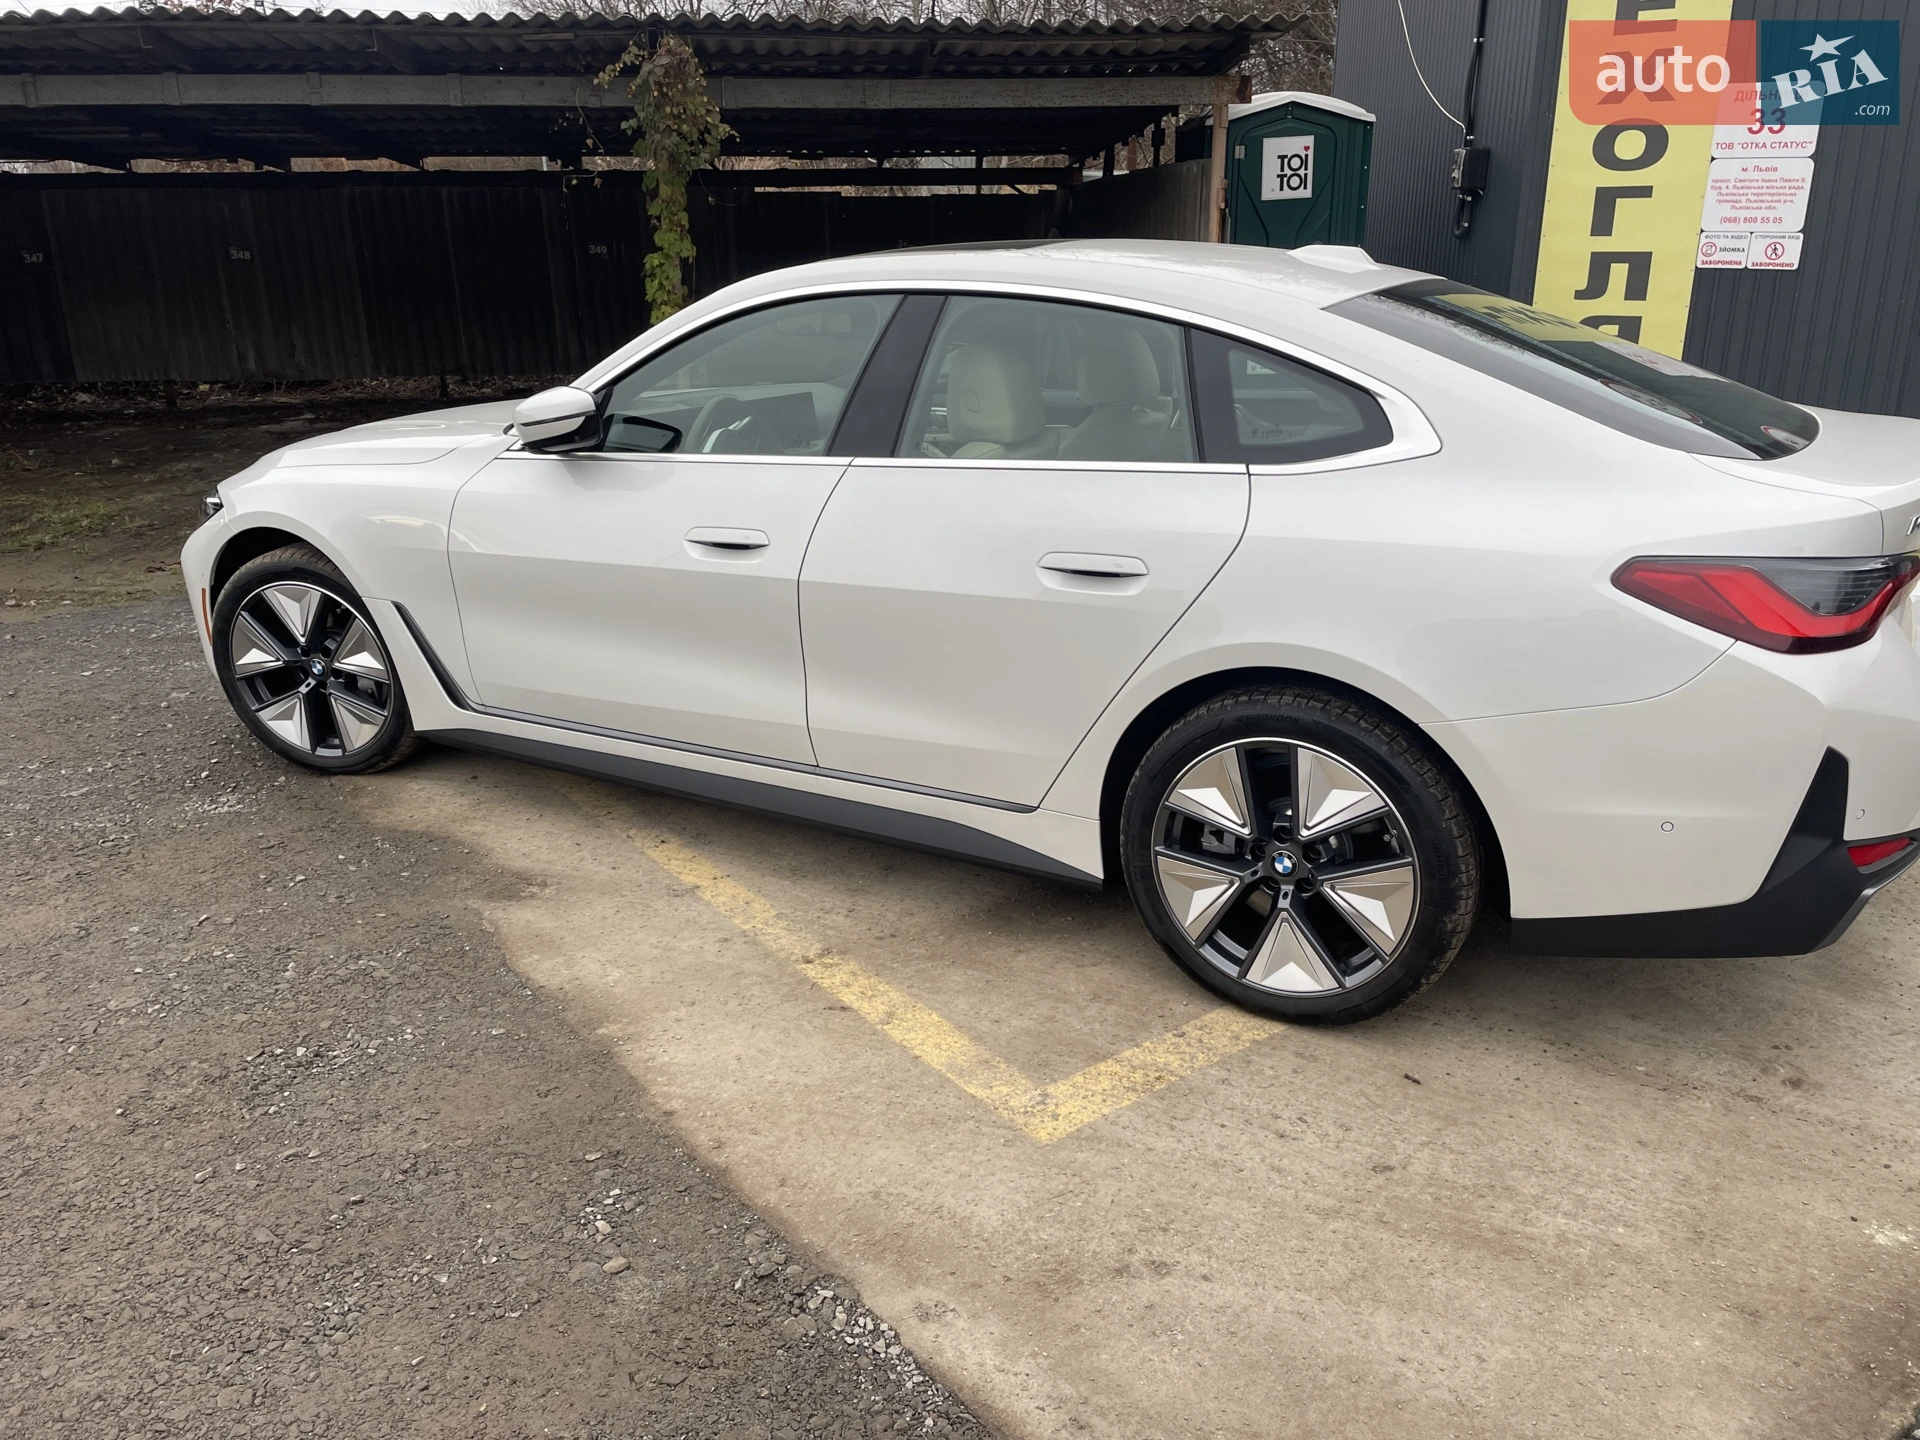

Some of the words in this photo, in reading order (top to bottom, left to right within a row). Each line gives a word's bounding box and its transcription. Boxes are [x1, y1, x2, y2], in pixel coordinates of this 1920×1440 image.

[1747, 108, 1787, 135] 33
[1715, 142, 1734, 150] ТОВ
[1737, 142, 1767, 150] "ОТКА
[1770, 141, 1813, 149] СТАТУС"
[1277, 153, 1309, 172] TOI
[1753, 165, 1779, 173] Львів
[1276, 172, 1308, 192] TOI
[1719, 217, 1741, 225] (068)
[588, 244, 607, 255] 349
[1718, 245, 1746, 253] ЗЙОМКА
[23, 253, 43, 263] 347
[230, 250, 251, 260] 348
